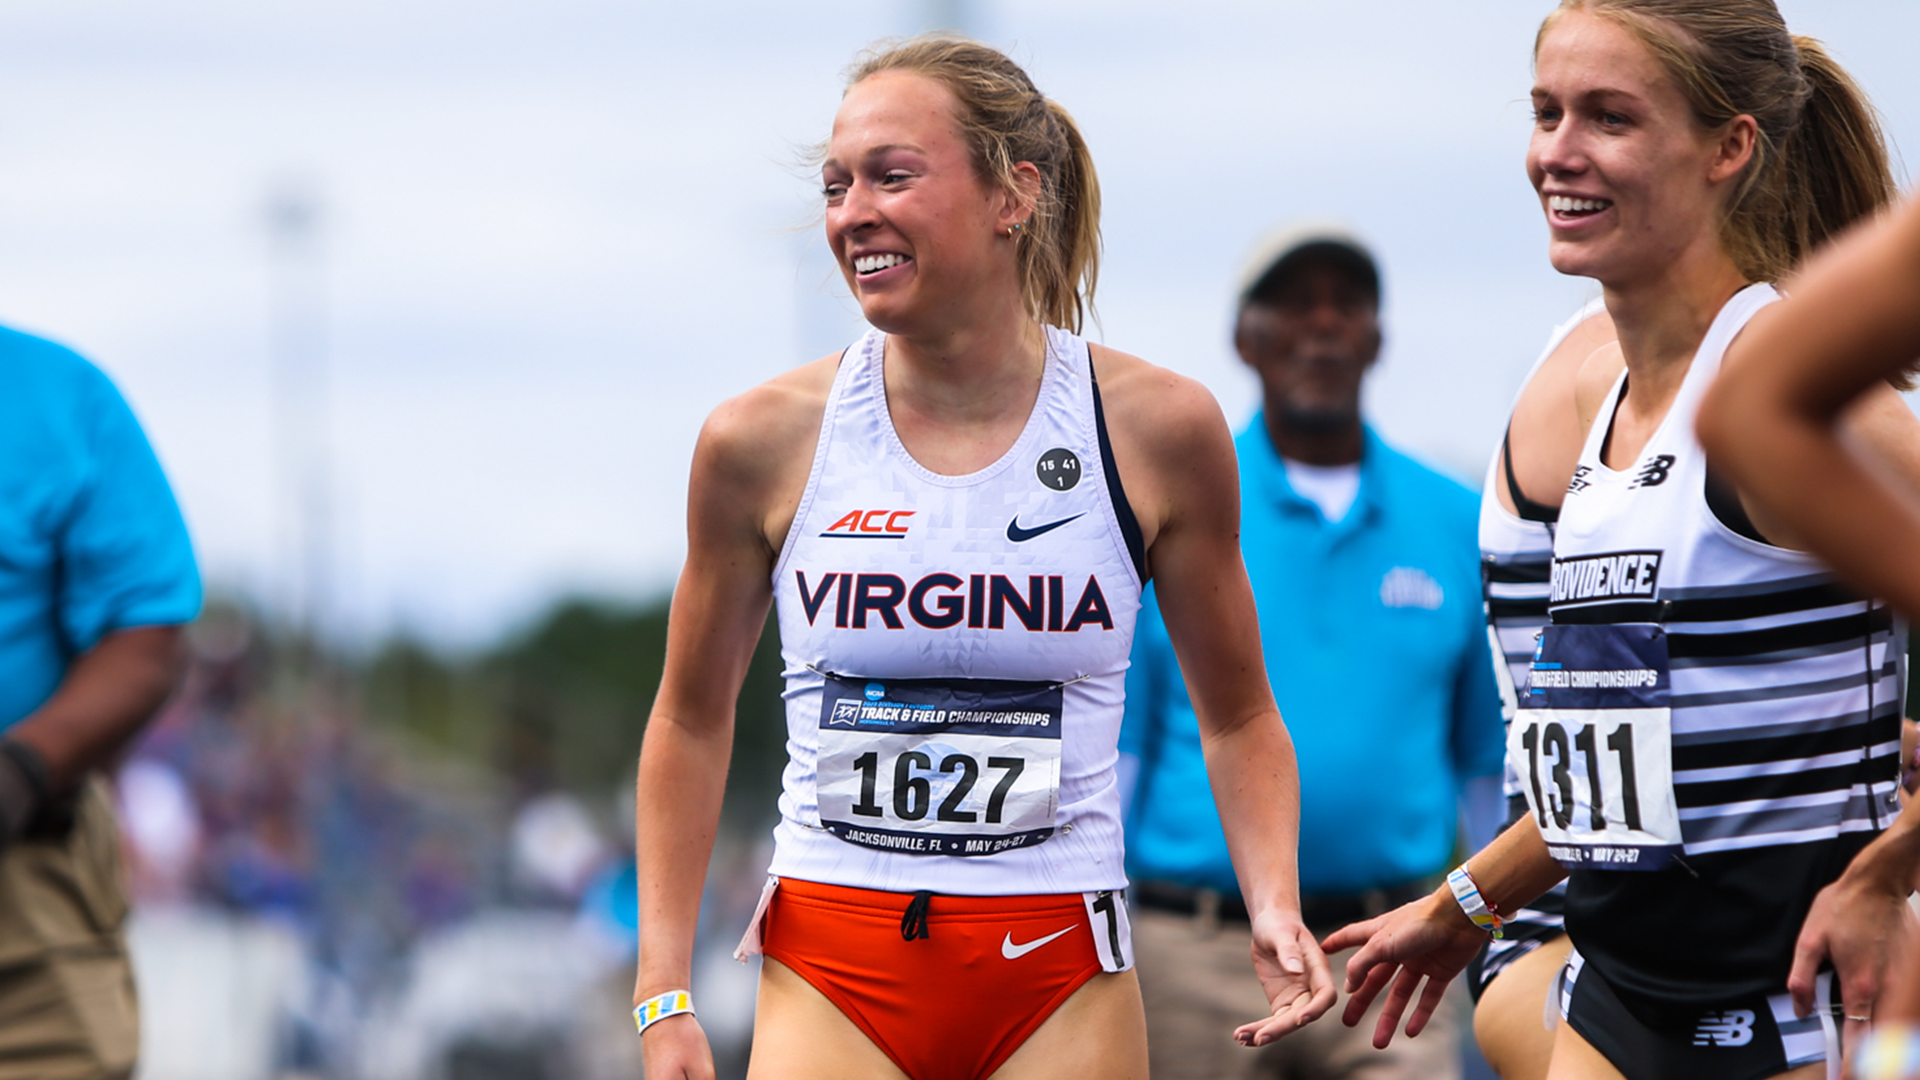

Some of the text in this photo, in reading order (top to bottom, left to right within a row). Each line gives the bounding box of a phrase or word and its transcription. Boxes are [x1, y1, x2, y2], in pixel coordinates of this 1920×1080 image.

[1041, 459, 1076, 471] 15 41
[1057, 476, 1064, 487] 1
[827, 510, 917, 533] ACC
[795, 570, 1115, 632] VIRGINIA
[1571, 669, 1658, 688] CHAMPIONSHIPS
[860, 707, 1050, 727] TRACK & FIELD CHAMPIONSHIPS
[1522, 722, 1644, 831] 1311
[852, 750, 1025, 825] 1627
[845, 830, 1027, 852] JACKSONVILLE, FL MAY 24-27
[1592, 848, 1614, 862] MAY
[1613, 848, 1640, 863] 24-27
